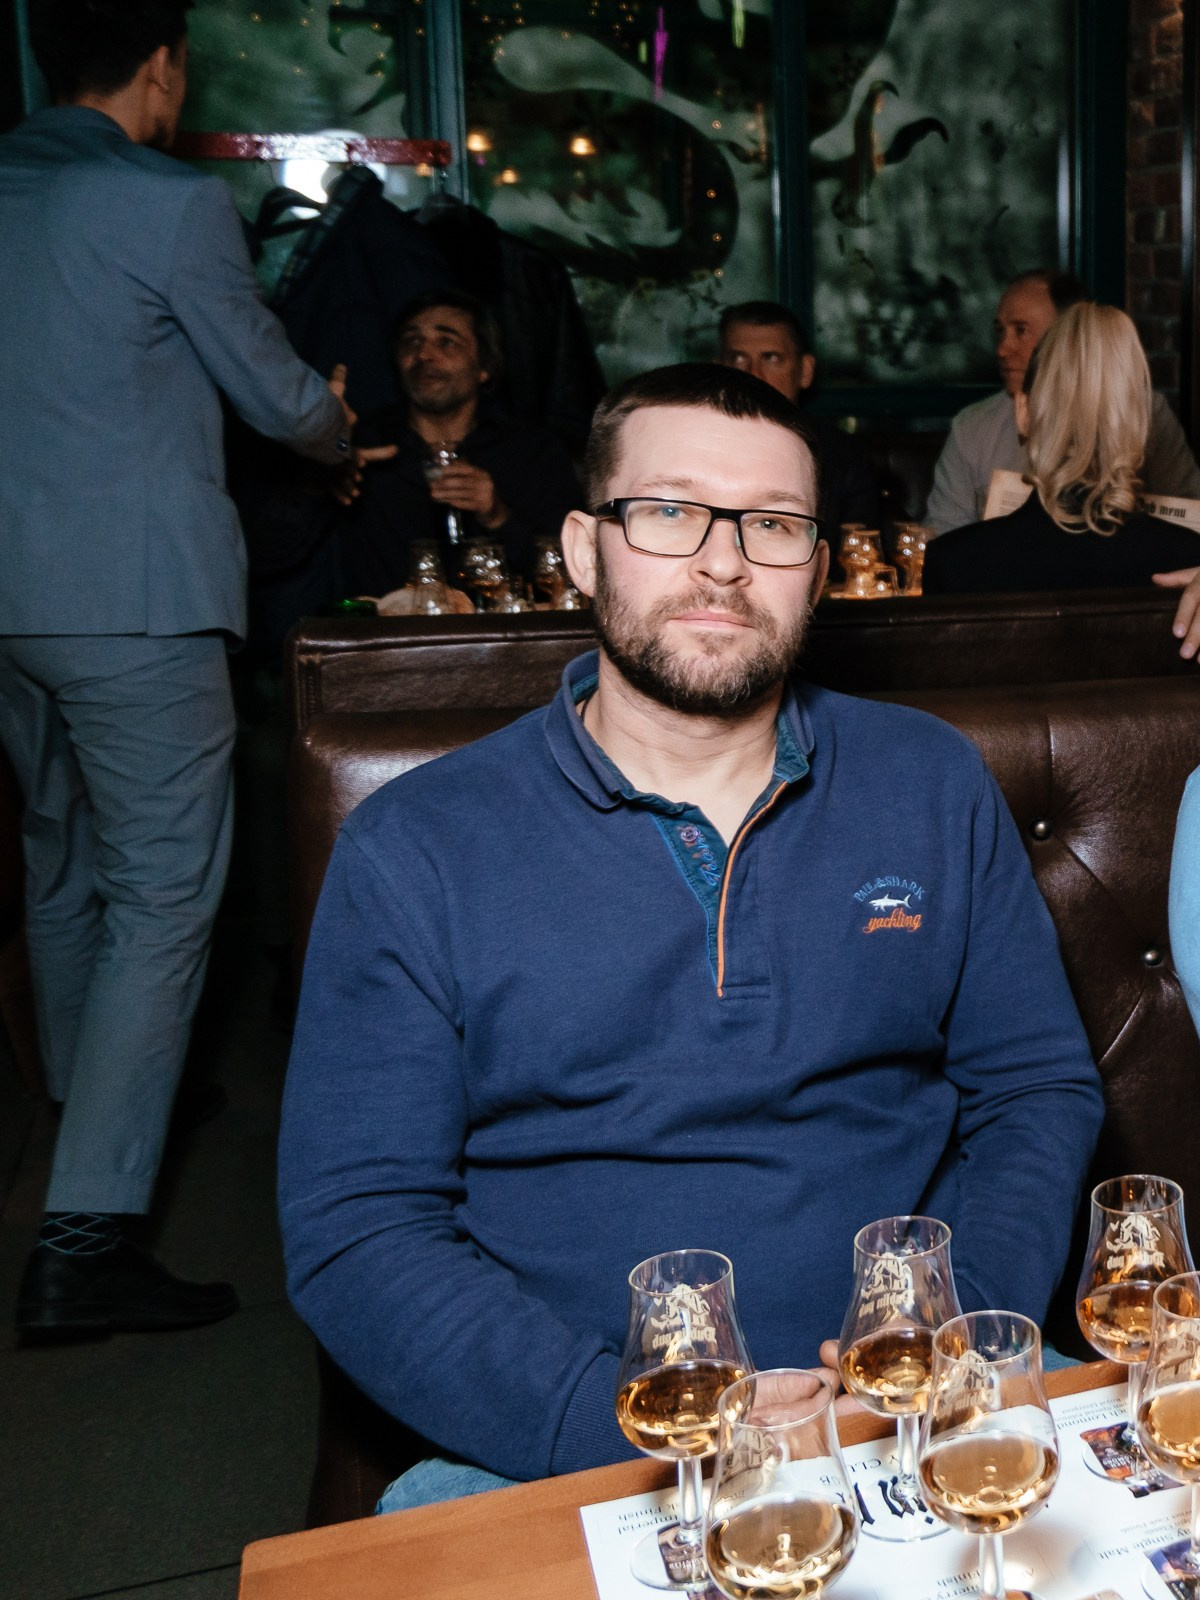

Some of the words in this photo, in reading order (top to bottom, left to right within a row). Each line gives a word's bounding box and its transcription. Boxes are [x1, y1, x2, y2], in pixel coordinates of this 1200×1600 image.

[1160, 505, 1187, 518] menu
[863, 908, 923, 934] yachting
[1056, 1413, 1107, 1430] Lomond
[617, 1506, 661, 1520] Finish
[617, 1514, 678, 1534] Imperial
[1133, 1534, 1174, 1549] Single
[1098, 1546, 1129, 1560] Malt
[937, 1570, 980, 1587] Finish
